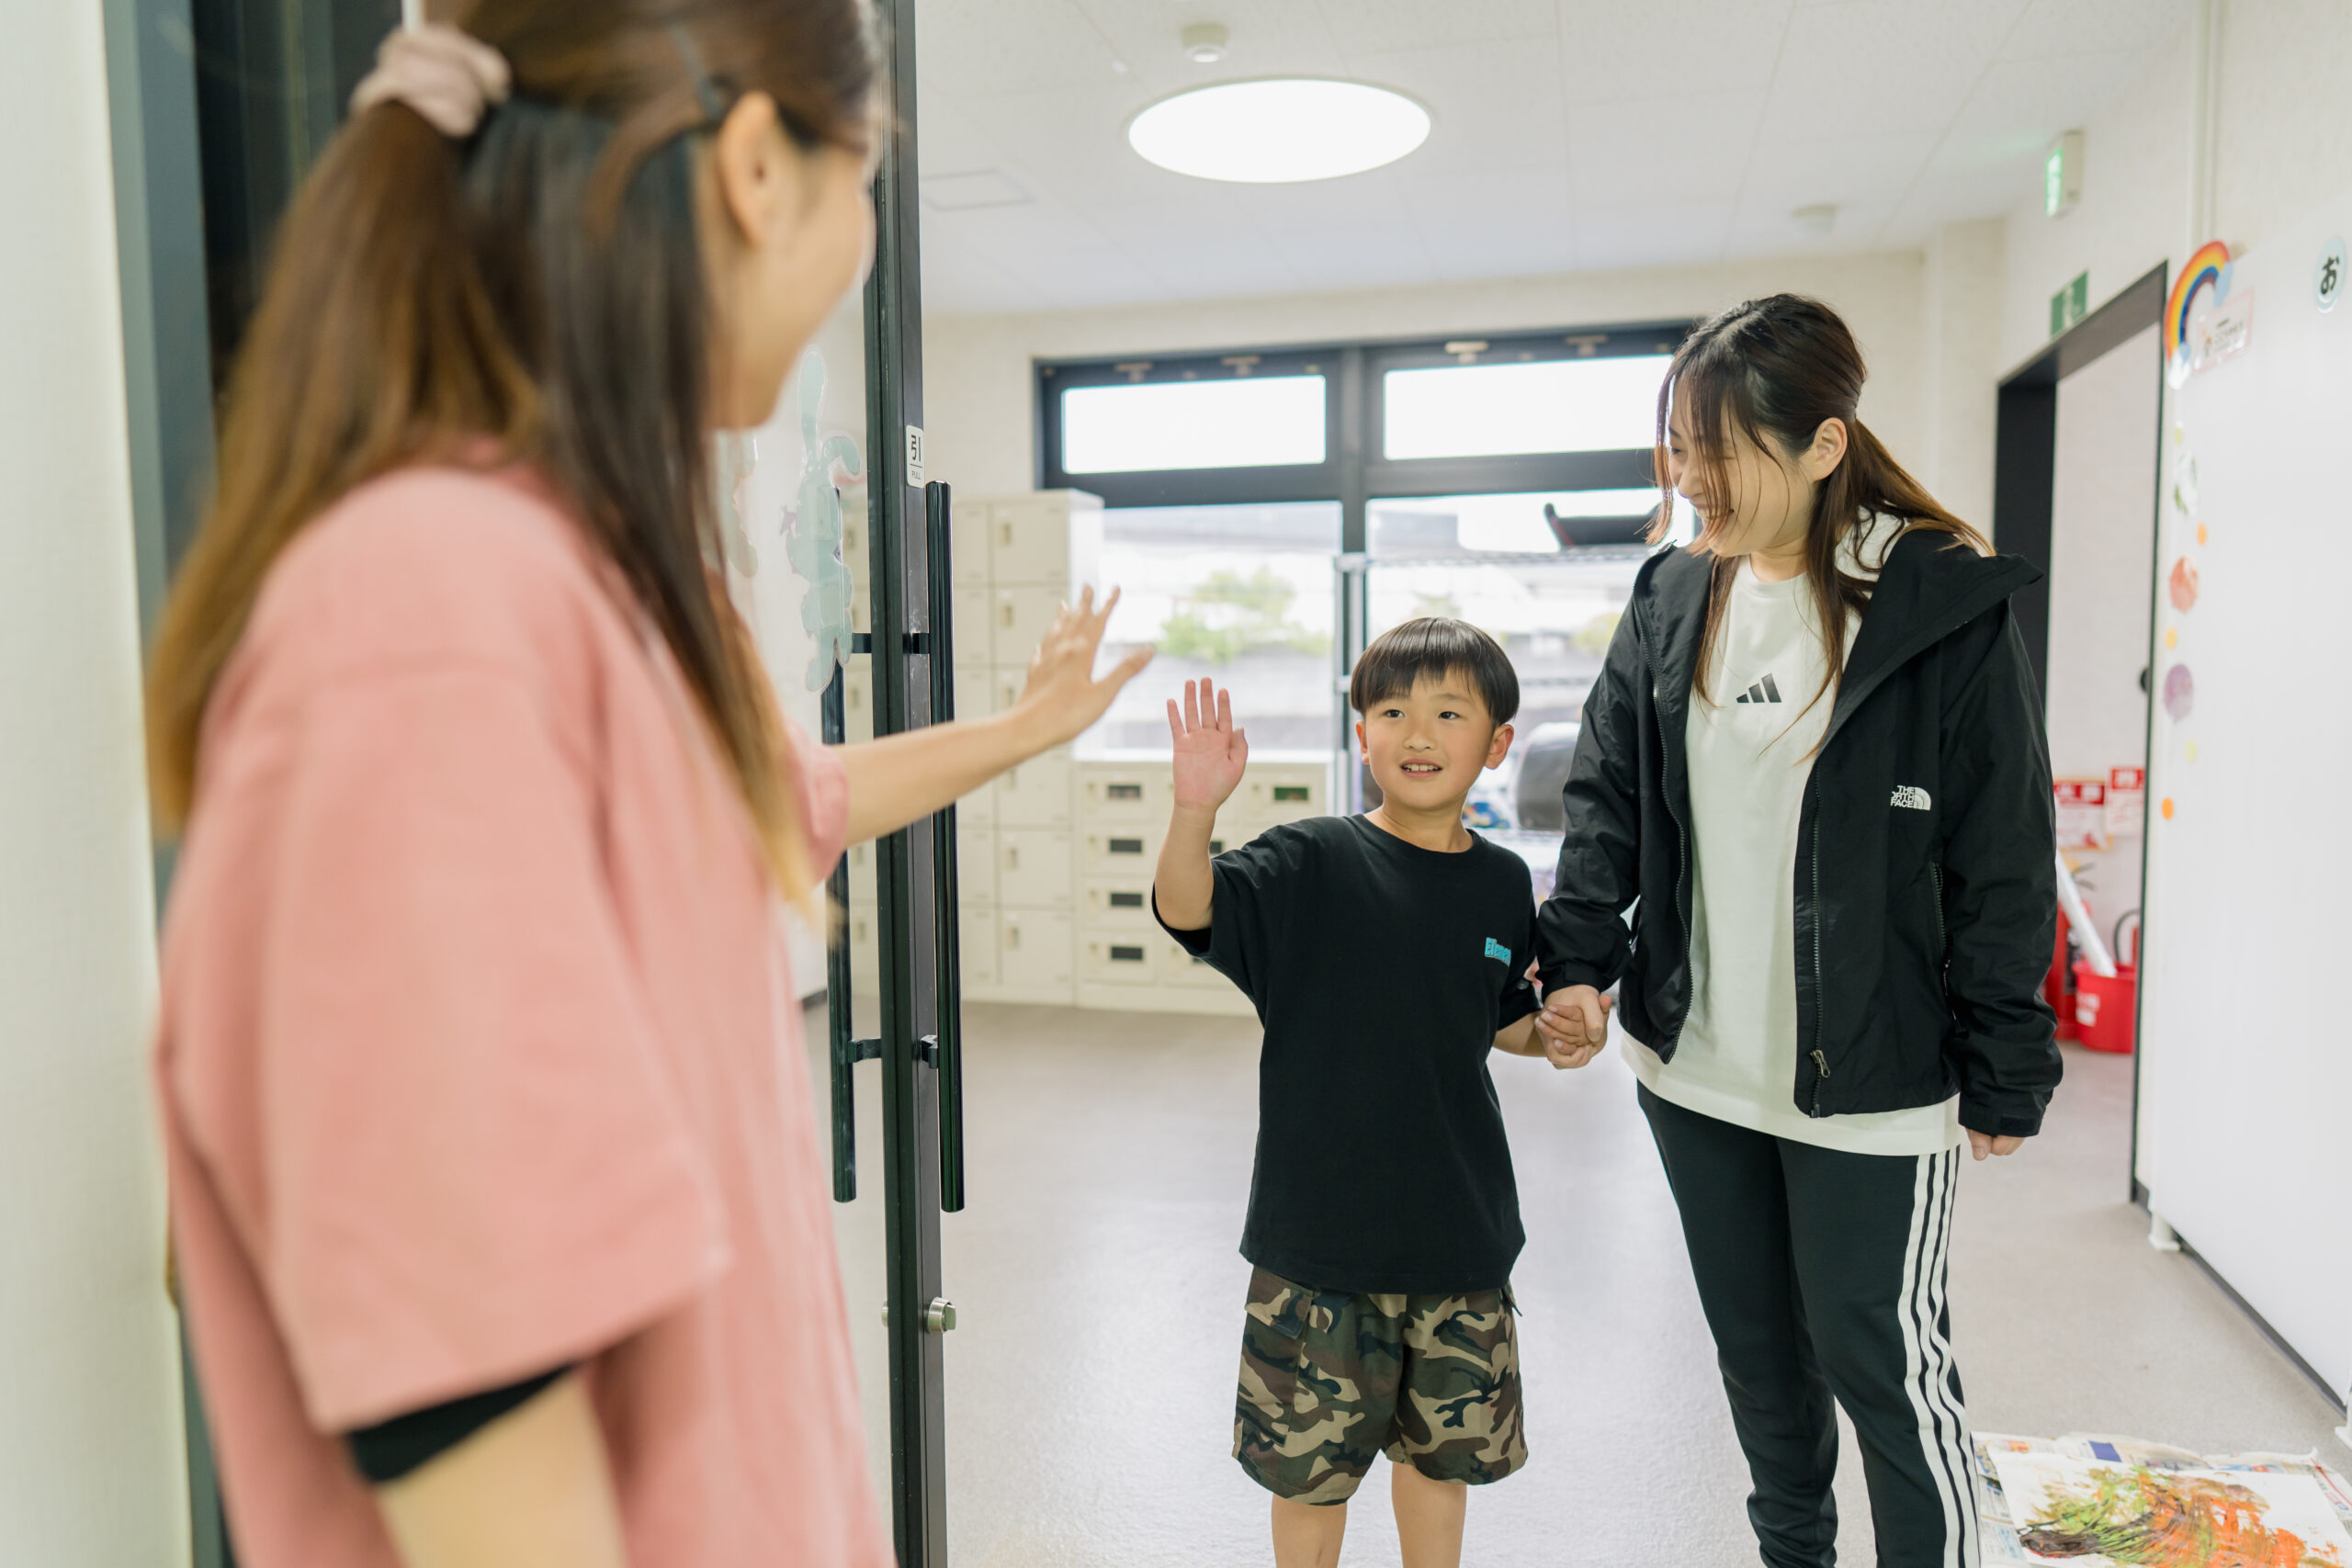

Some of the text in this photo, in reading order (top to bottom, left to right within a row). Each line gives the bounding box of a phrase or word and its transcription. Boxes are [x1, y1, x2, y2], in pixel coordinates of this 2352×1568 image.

[2321, 255, 2340, 295] お
[910, 434, 922, 462] 引
[1896, 785, 1915, 795] THE
[1890, 798, 1915, 808] FACE
